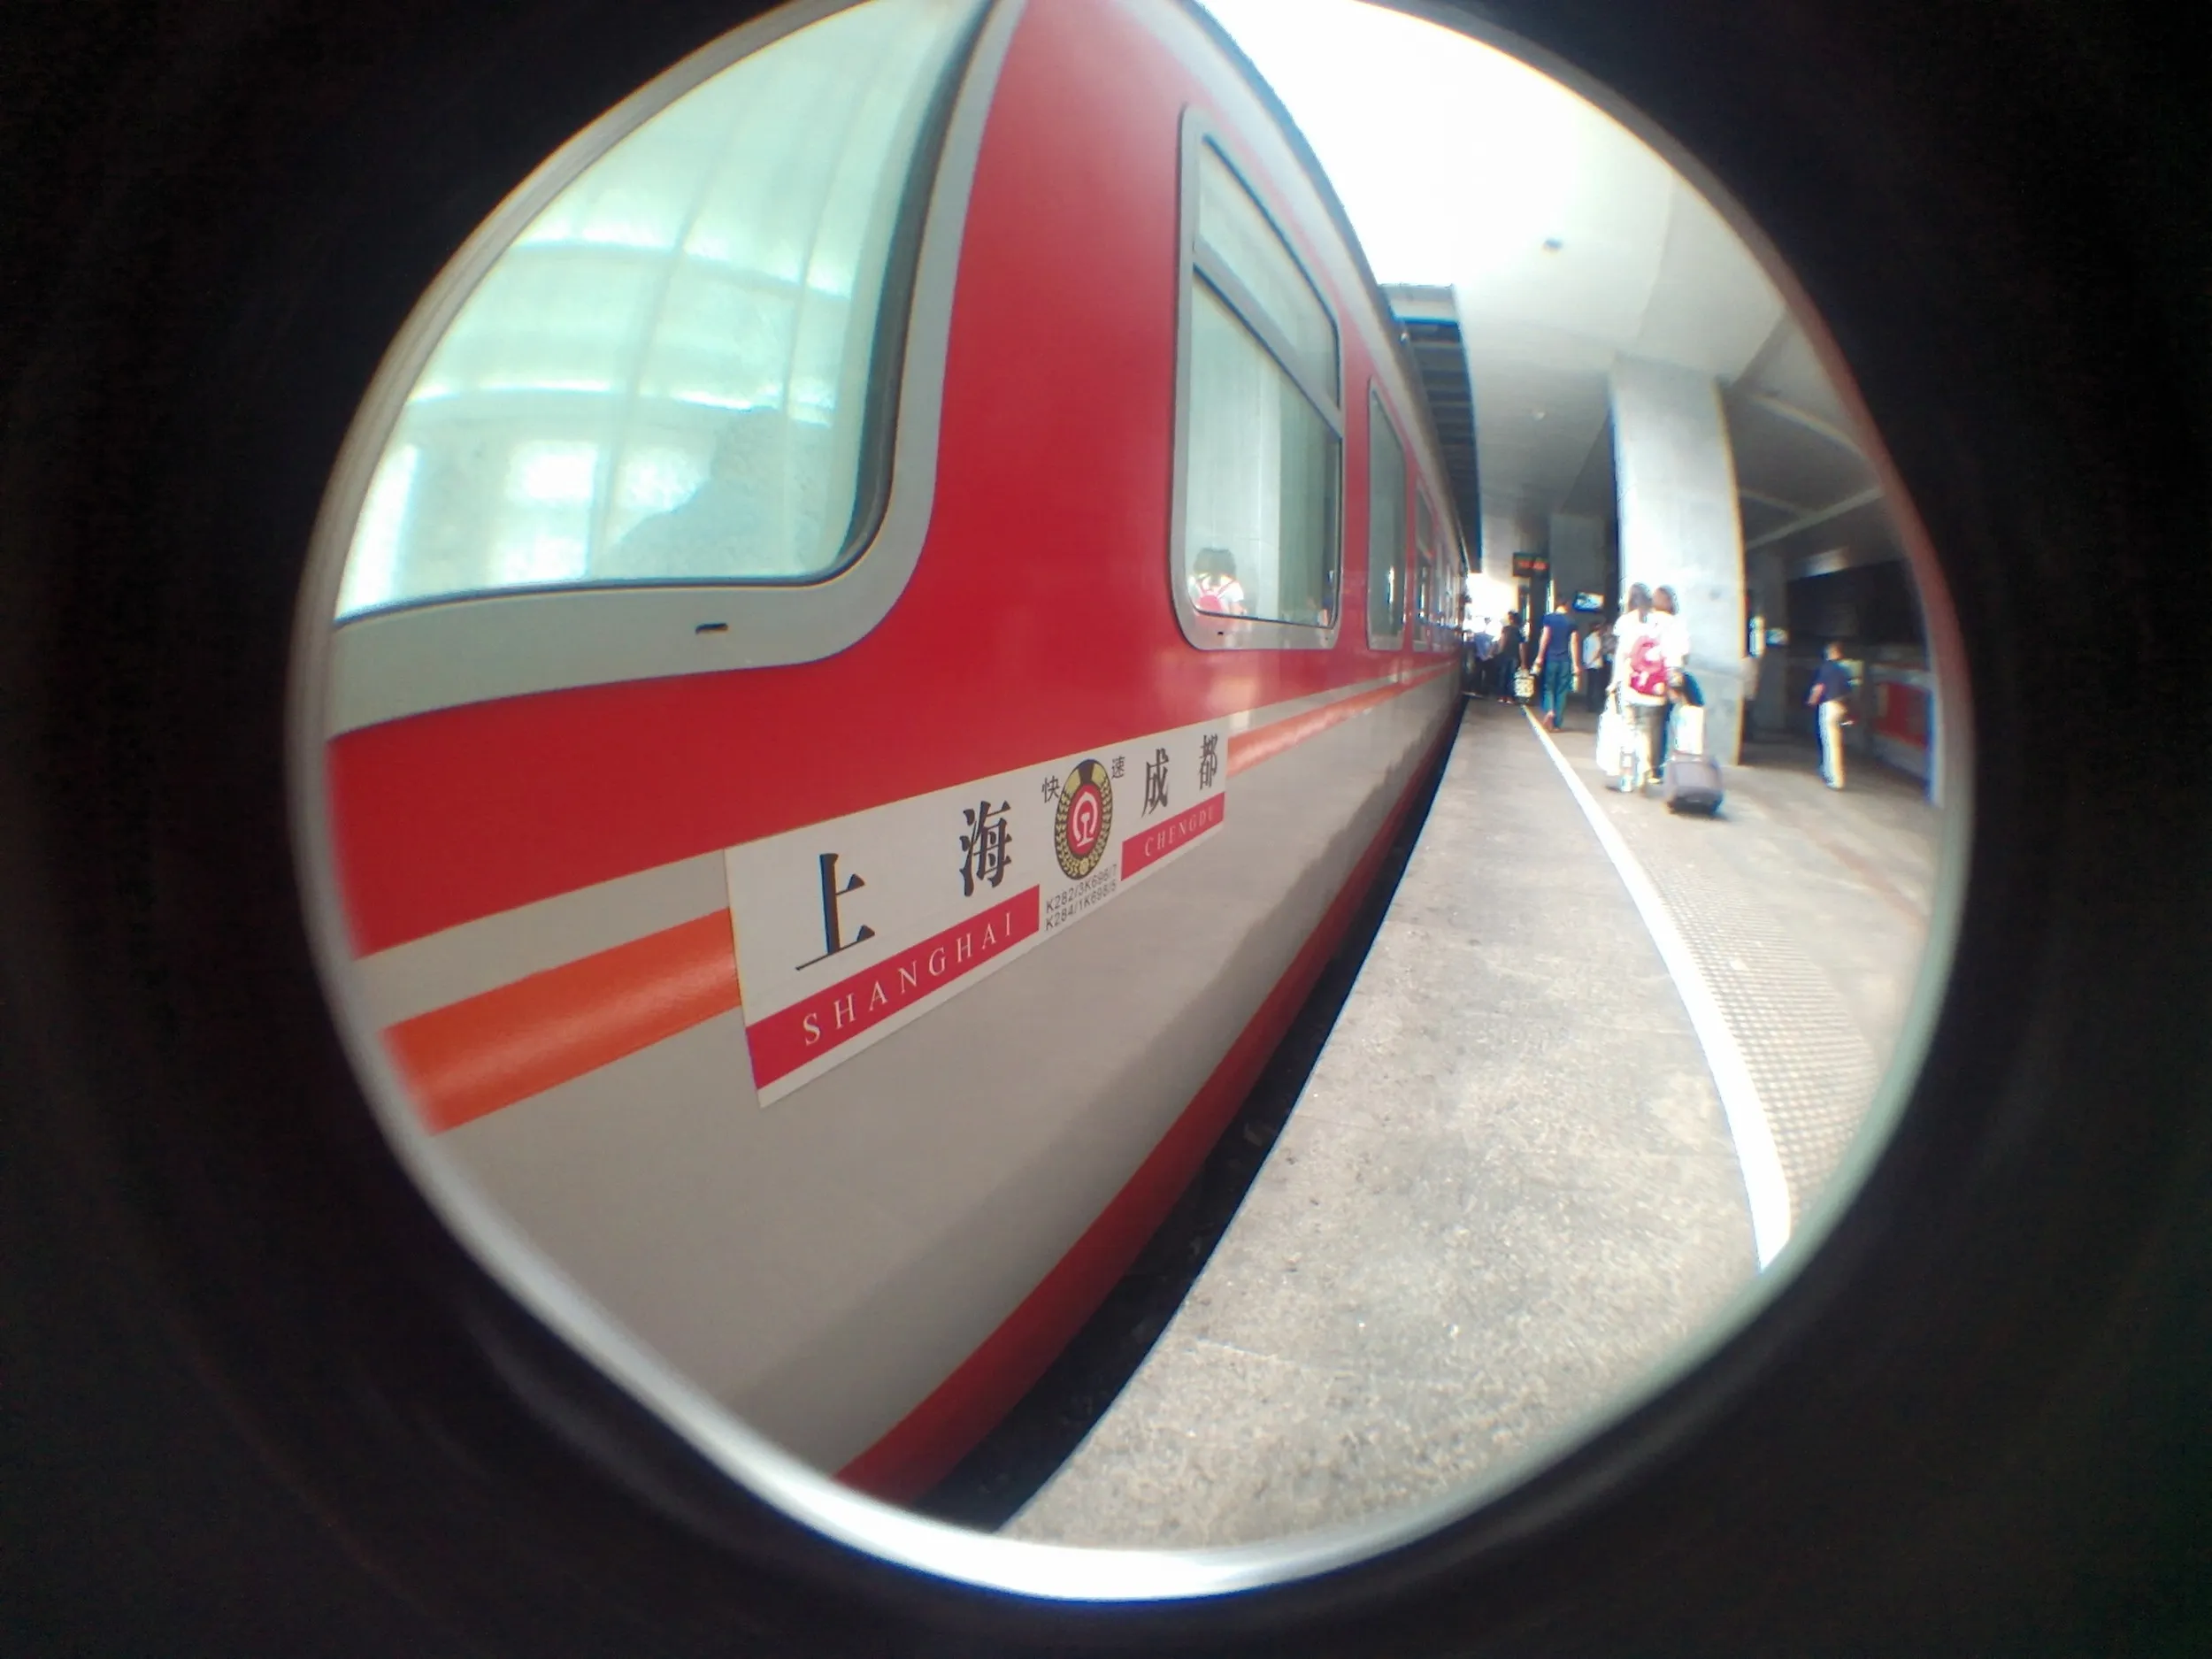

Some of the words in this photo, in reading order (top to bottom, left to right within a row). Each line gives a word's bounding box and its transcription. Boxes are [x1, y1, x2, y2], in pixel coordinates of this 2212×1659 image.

[1141, 733, 1218, 818] 成都
[1144, 804, 1216, 857] CHENGDU
[795, 799, 1013, 972] 上海
[803, 911, 1013, 1046] SHANGHAI
